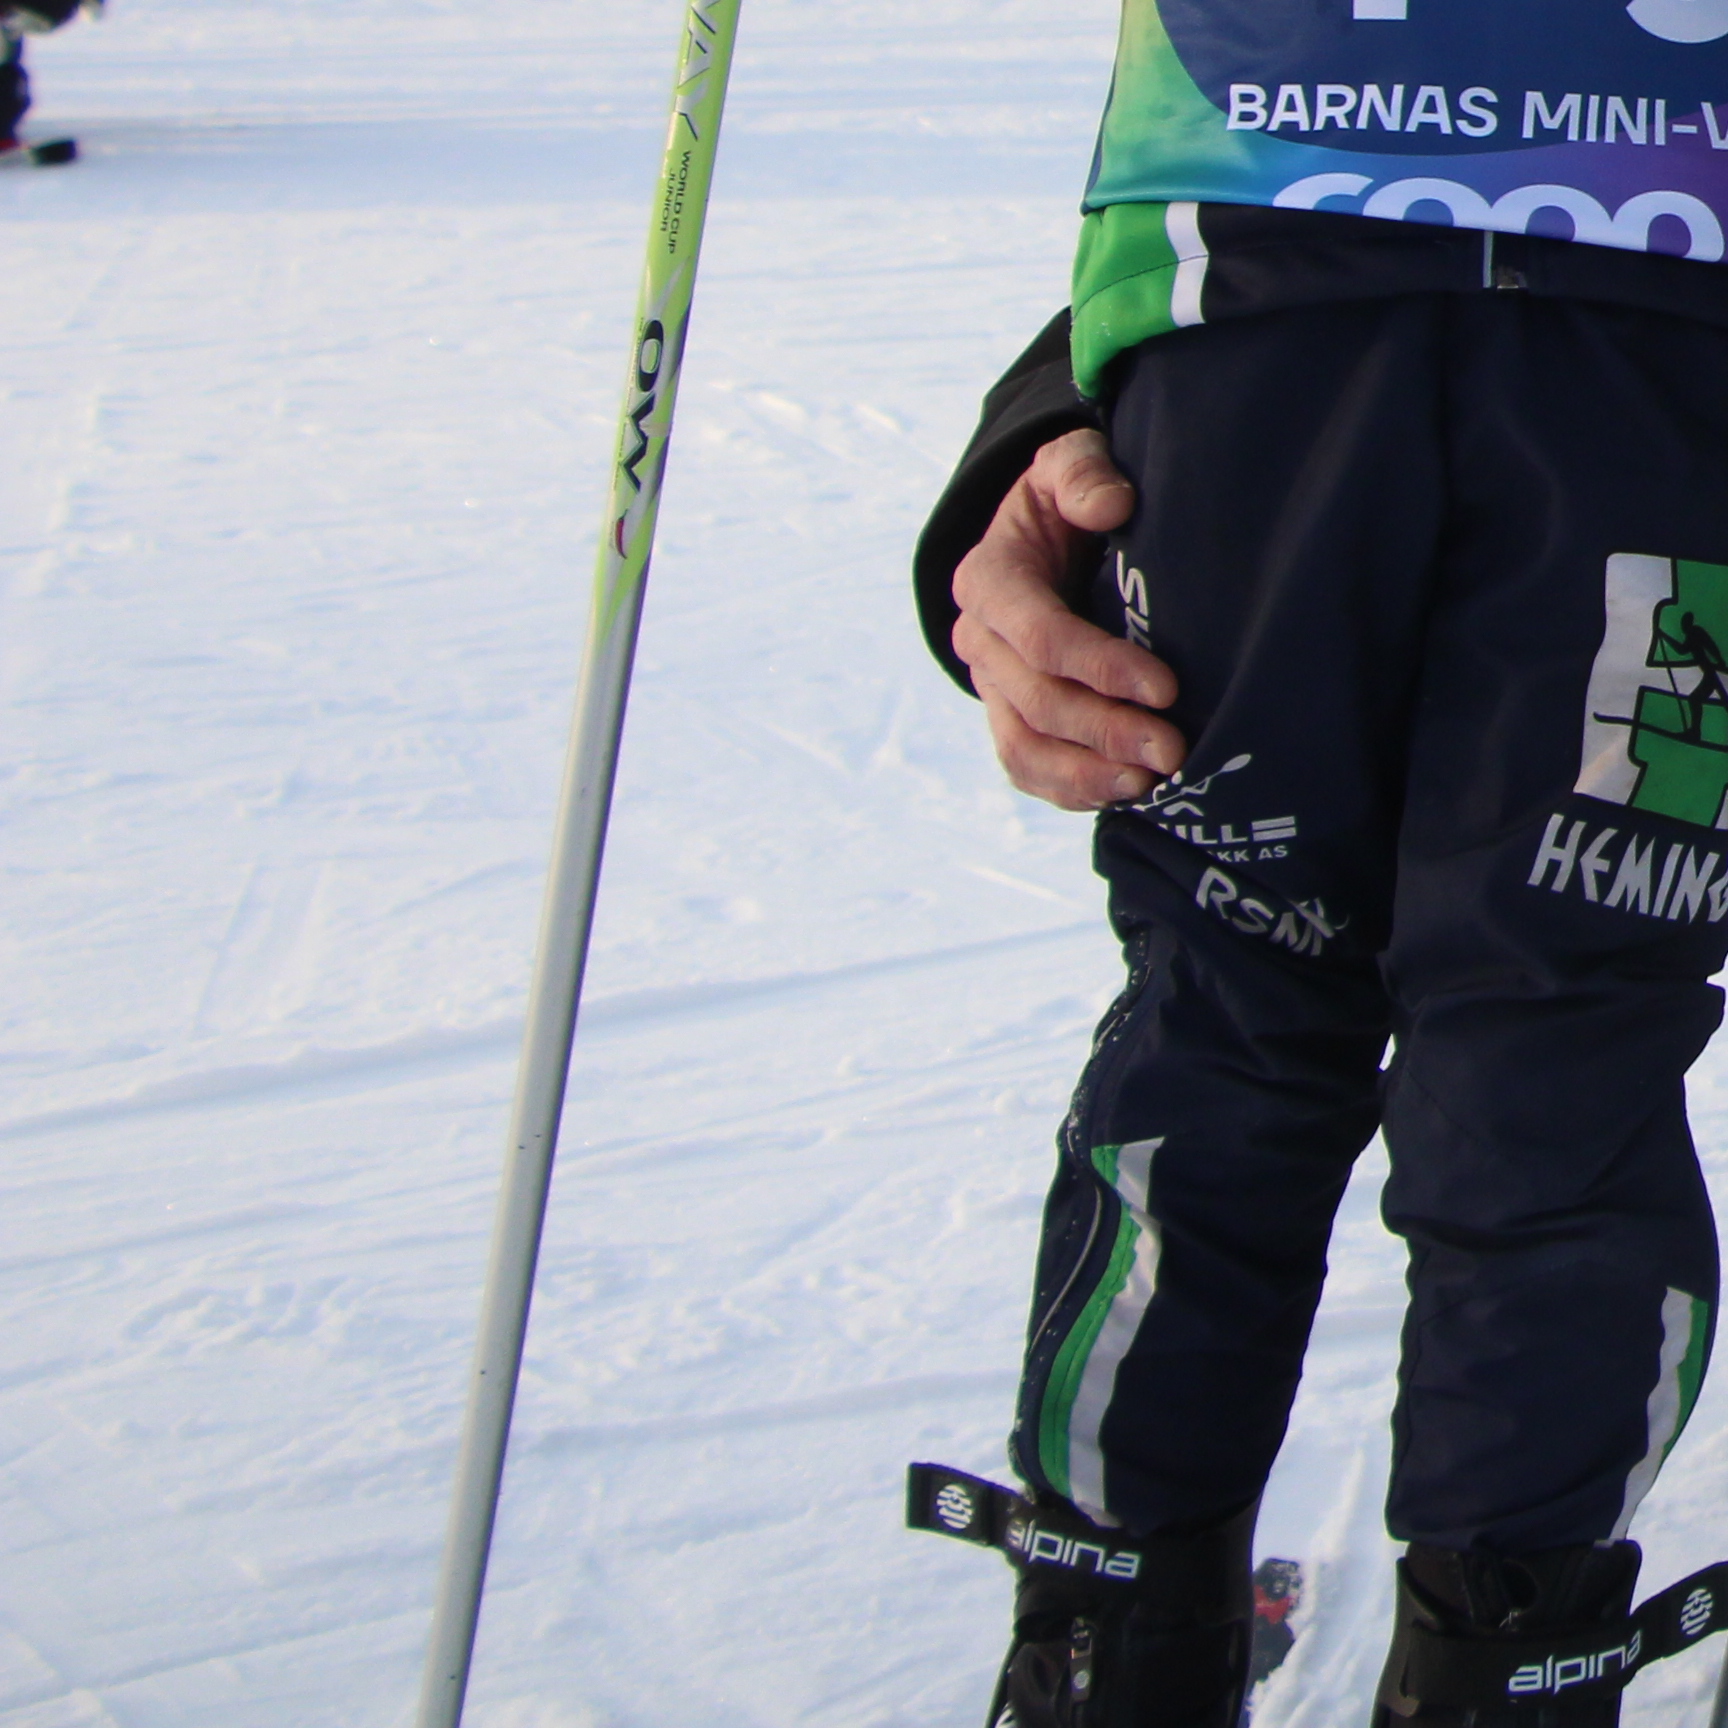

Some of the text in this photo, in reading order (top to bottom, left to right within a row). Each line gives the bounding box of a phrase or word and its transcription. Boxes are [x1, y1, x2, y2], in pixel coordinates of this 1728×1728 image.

[1226, 83, 1499, 139] BARNAS
[660, 168, 676, 232] JUNIOR
[667, 150, 691, 255] WORLD CUP
[620, 319, 665, 496] OW
[1257, 845, 1289, 860] AS
[1006, 1518, 1142, 1579] alpina
[1508, 1629, 1642, 1695] alpina
